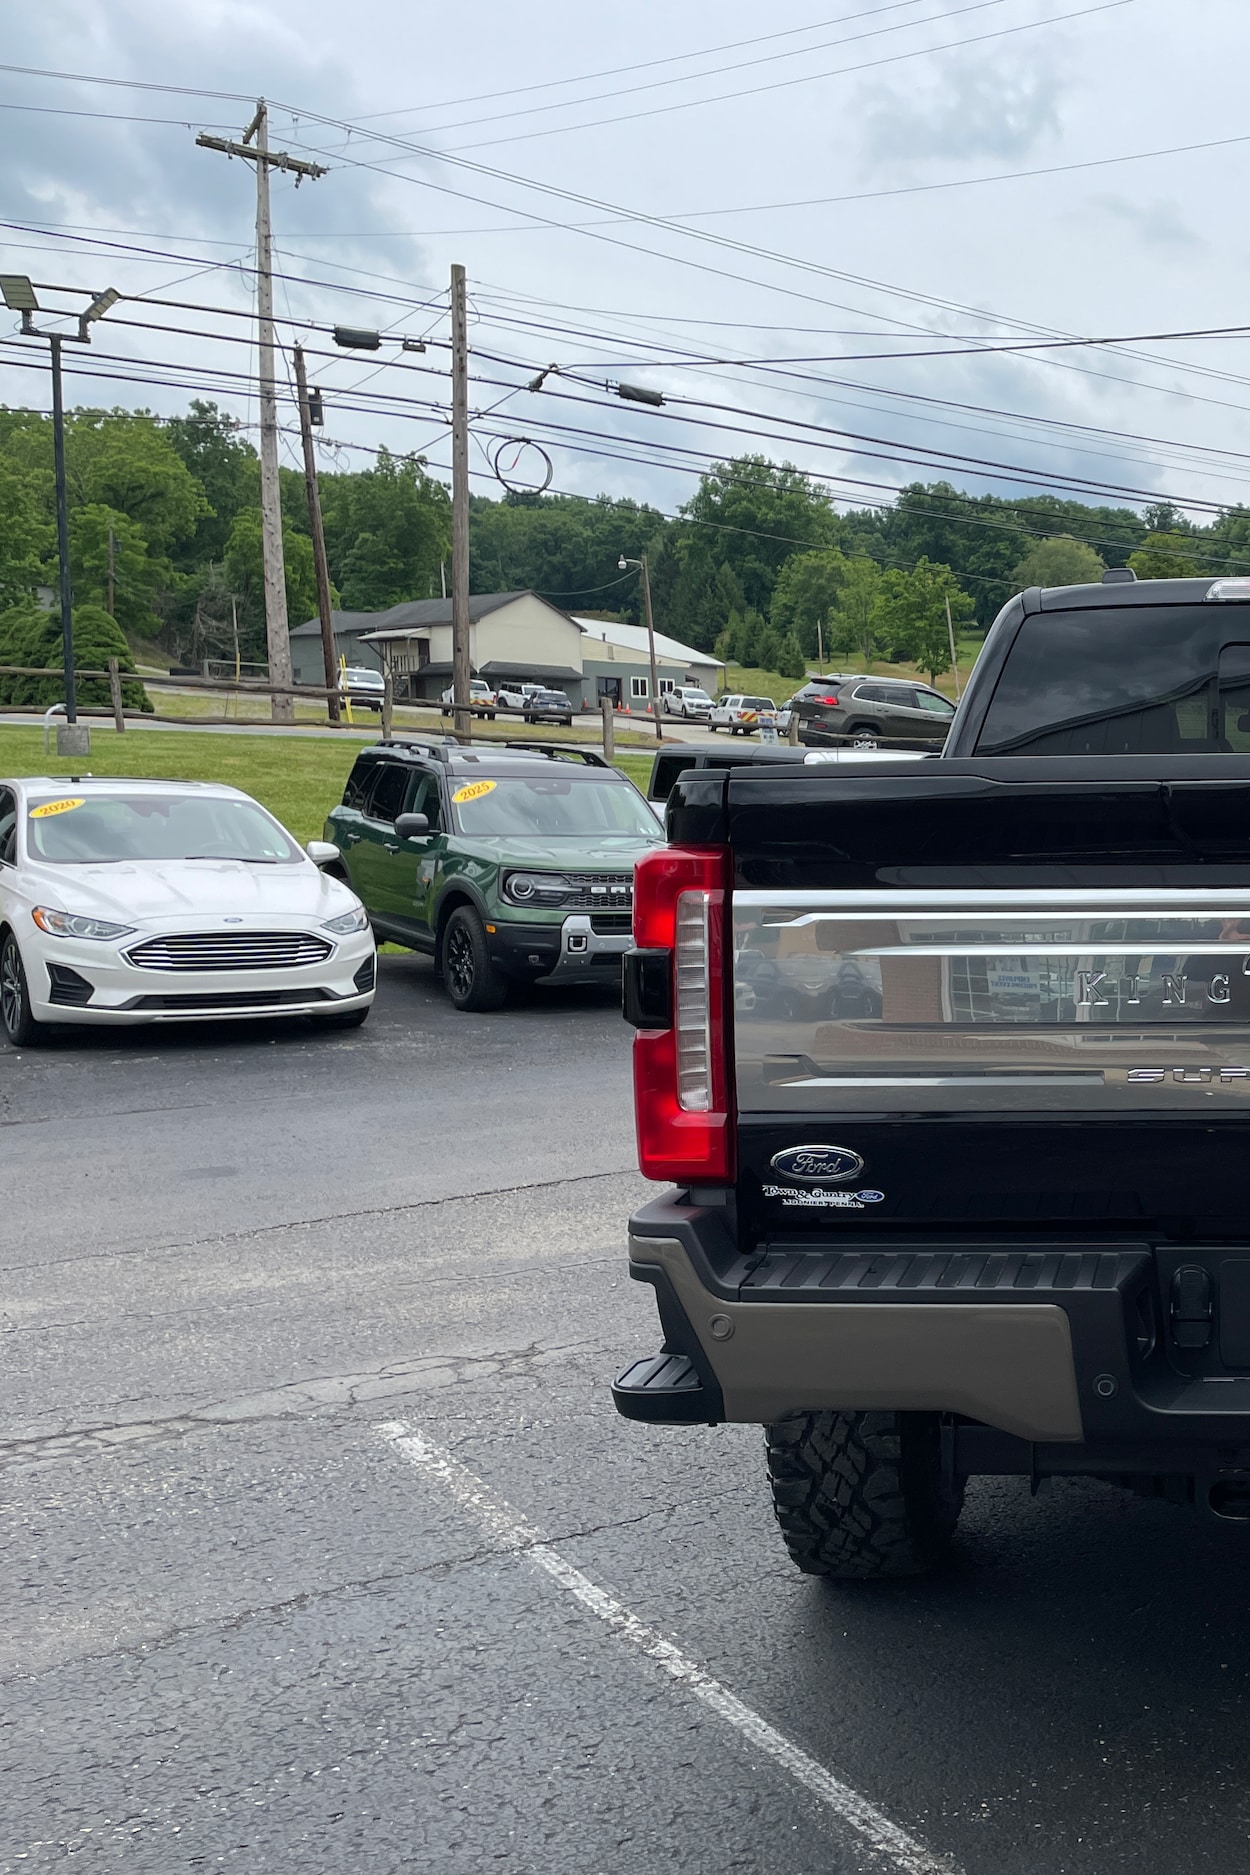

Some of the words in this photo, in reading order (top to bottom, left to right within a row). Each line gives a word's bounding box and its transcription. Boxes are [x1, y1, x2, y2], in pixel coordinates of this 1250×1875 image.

[460, 782, 490, 800] 2025
[40, 800, 75, 815] 2020
[1076, 969, 1231, 1006] KING
[791, 1152, 842, 1174] Ford
[761, 1184, 798, 1197] Town
